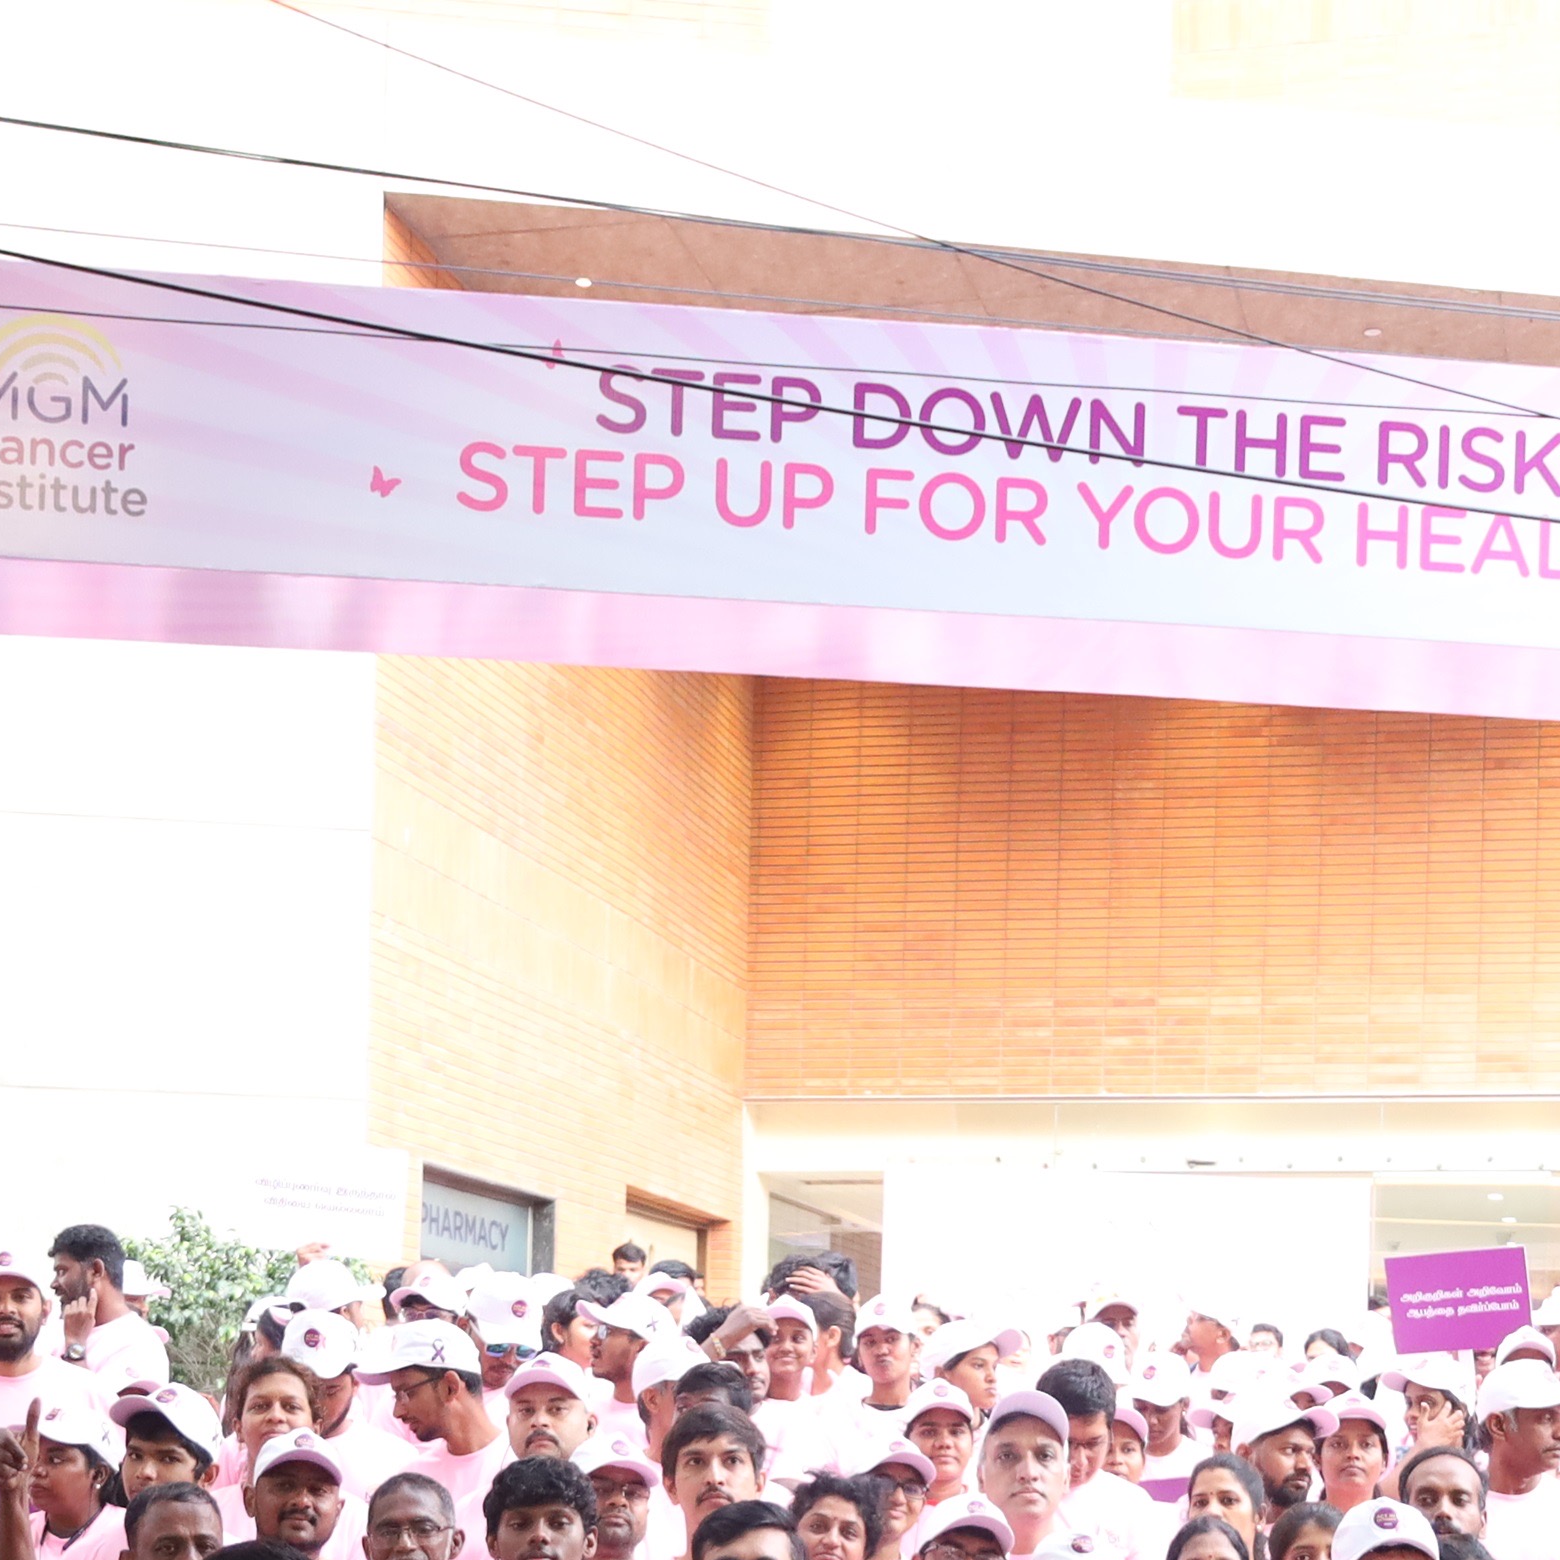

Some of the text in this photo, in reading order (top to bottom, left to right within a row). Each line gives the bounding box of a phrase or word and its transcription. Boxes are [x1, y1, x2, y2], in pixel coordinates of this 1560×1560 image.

[596, 363, 822, 443] STEP
[852, 380, 1146, 467] DOWN
[1176, 405, 1347, 482] THE
[456, 441, 686, 521] STEP
[715, 457, 835, 531] UP
[864, 467, 1048, 547] FOR
[1076, 482, 1325, 565] YOUR
[421, 1201, 510, 1253] PHARMACY
